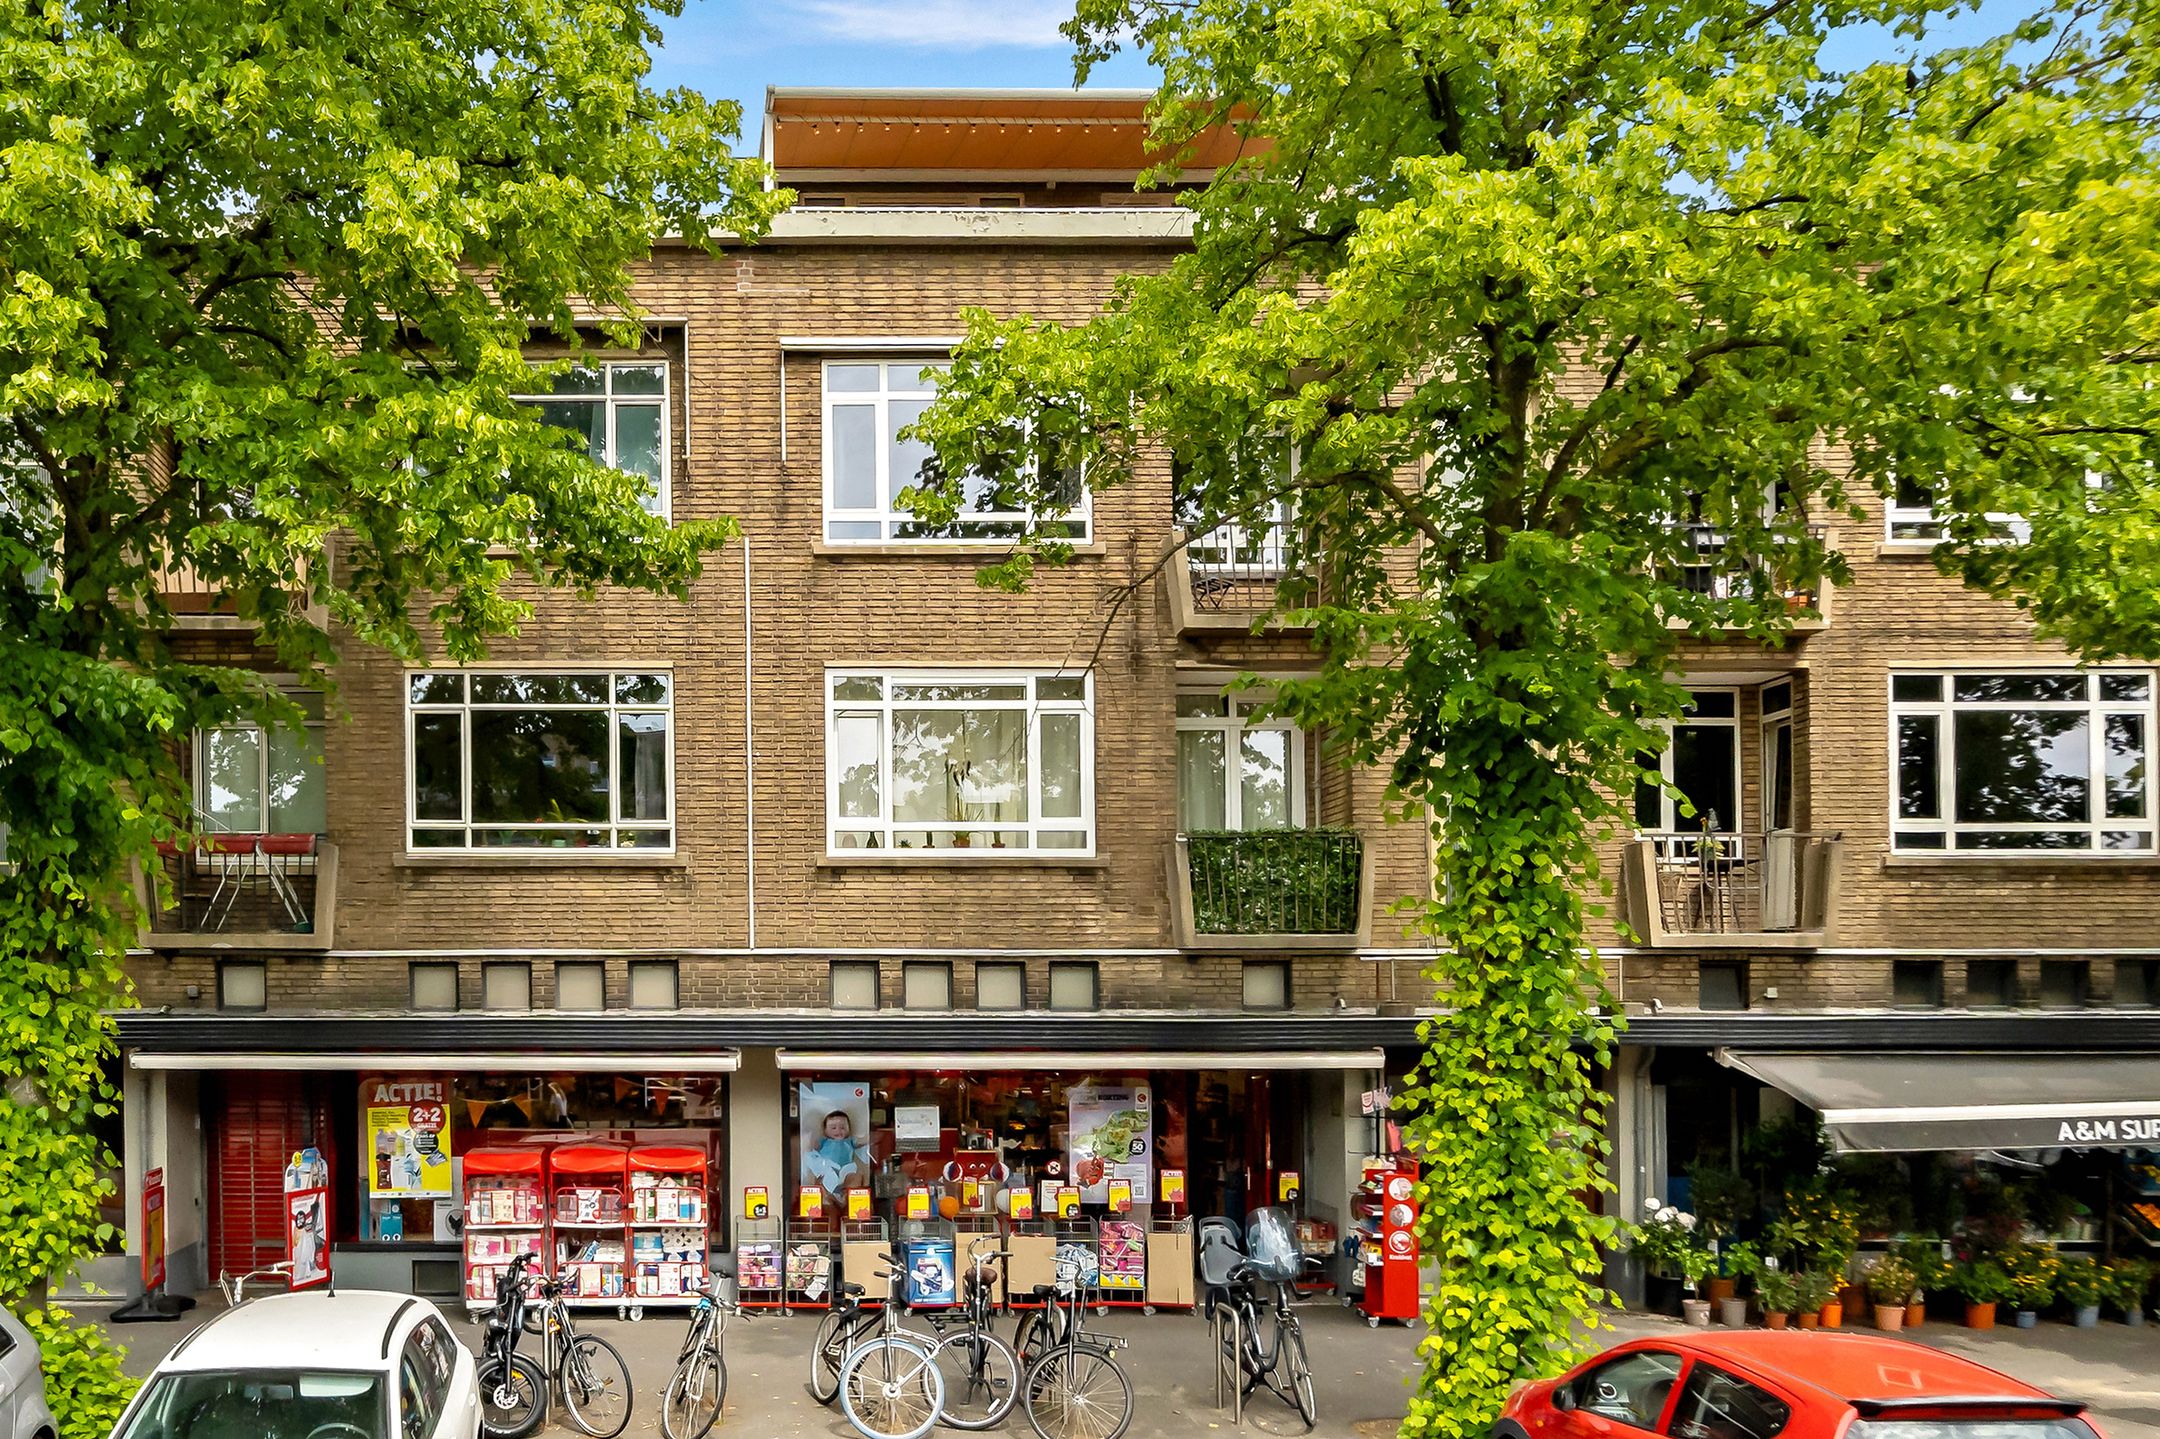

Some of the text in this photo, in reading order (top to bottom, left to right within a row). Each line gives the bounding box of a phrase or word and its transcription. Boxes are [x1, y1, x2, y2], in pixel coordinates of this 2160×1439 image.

[373, 1083, 442, 1102] ACTIE!
[413, 1107, 441, 1122] 2+2
[2058, 1120, 2117, 1141] A&M
